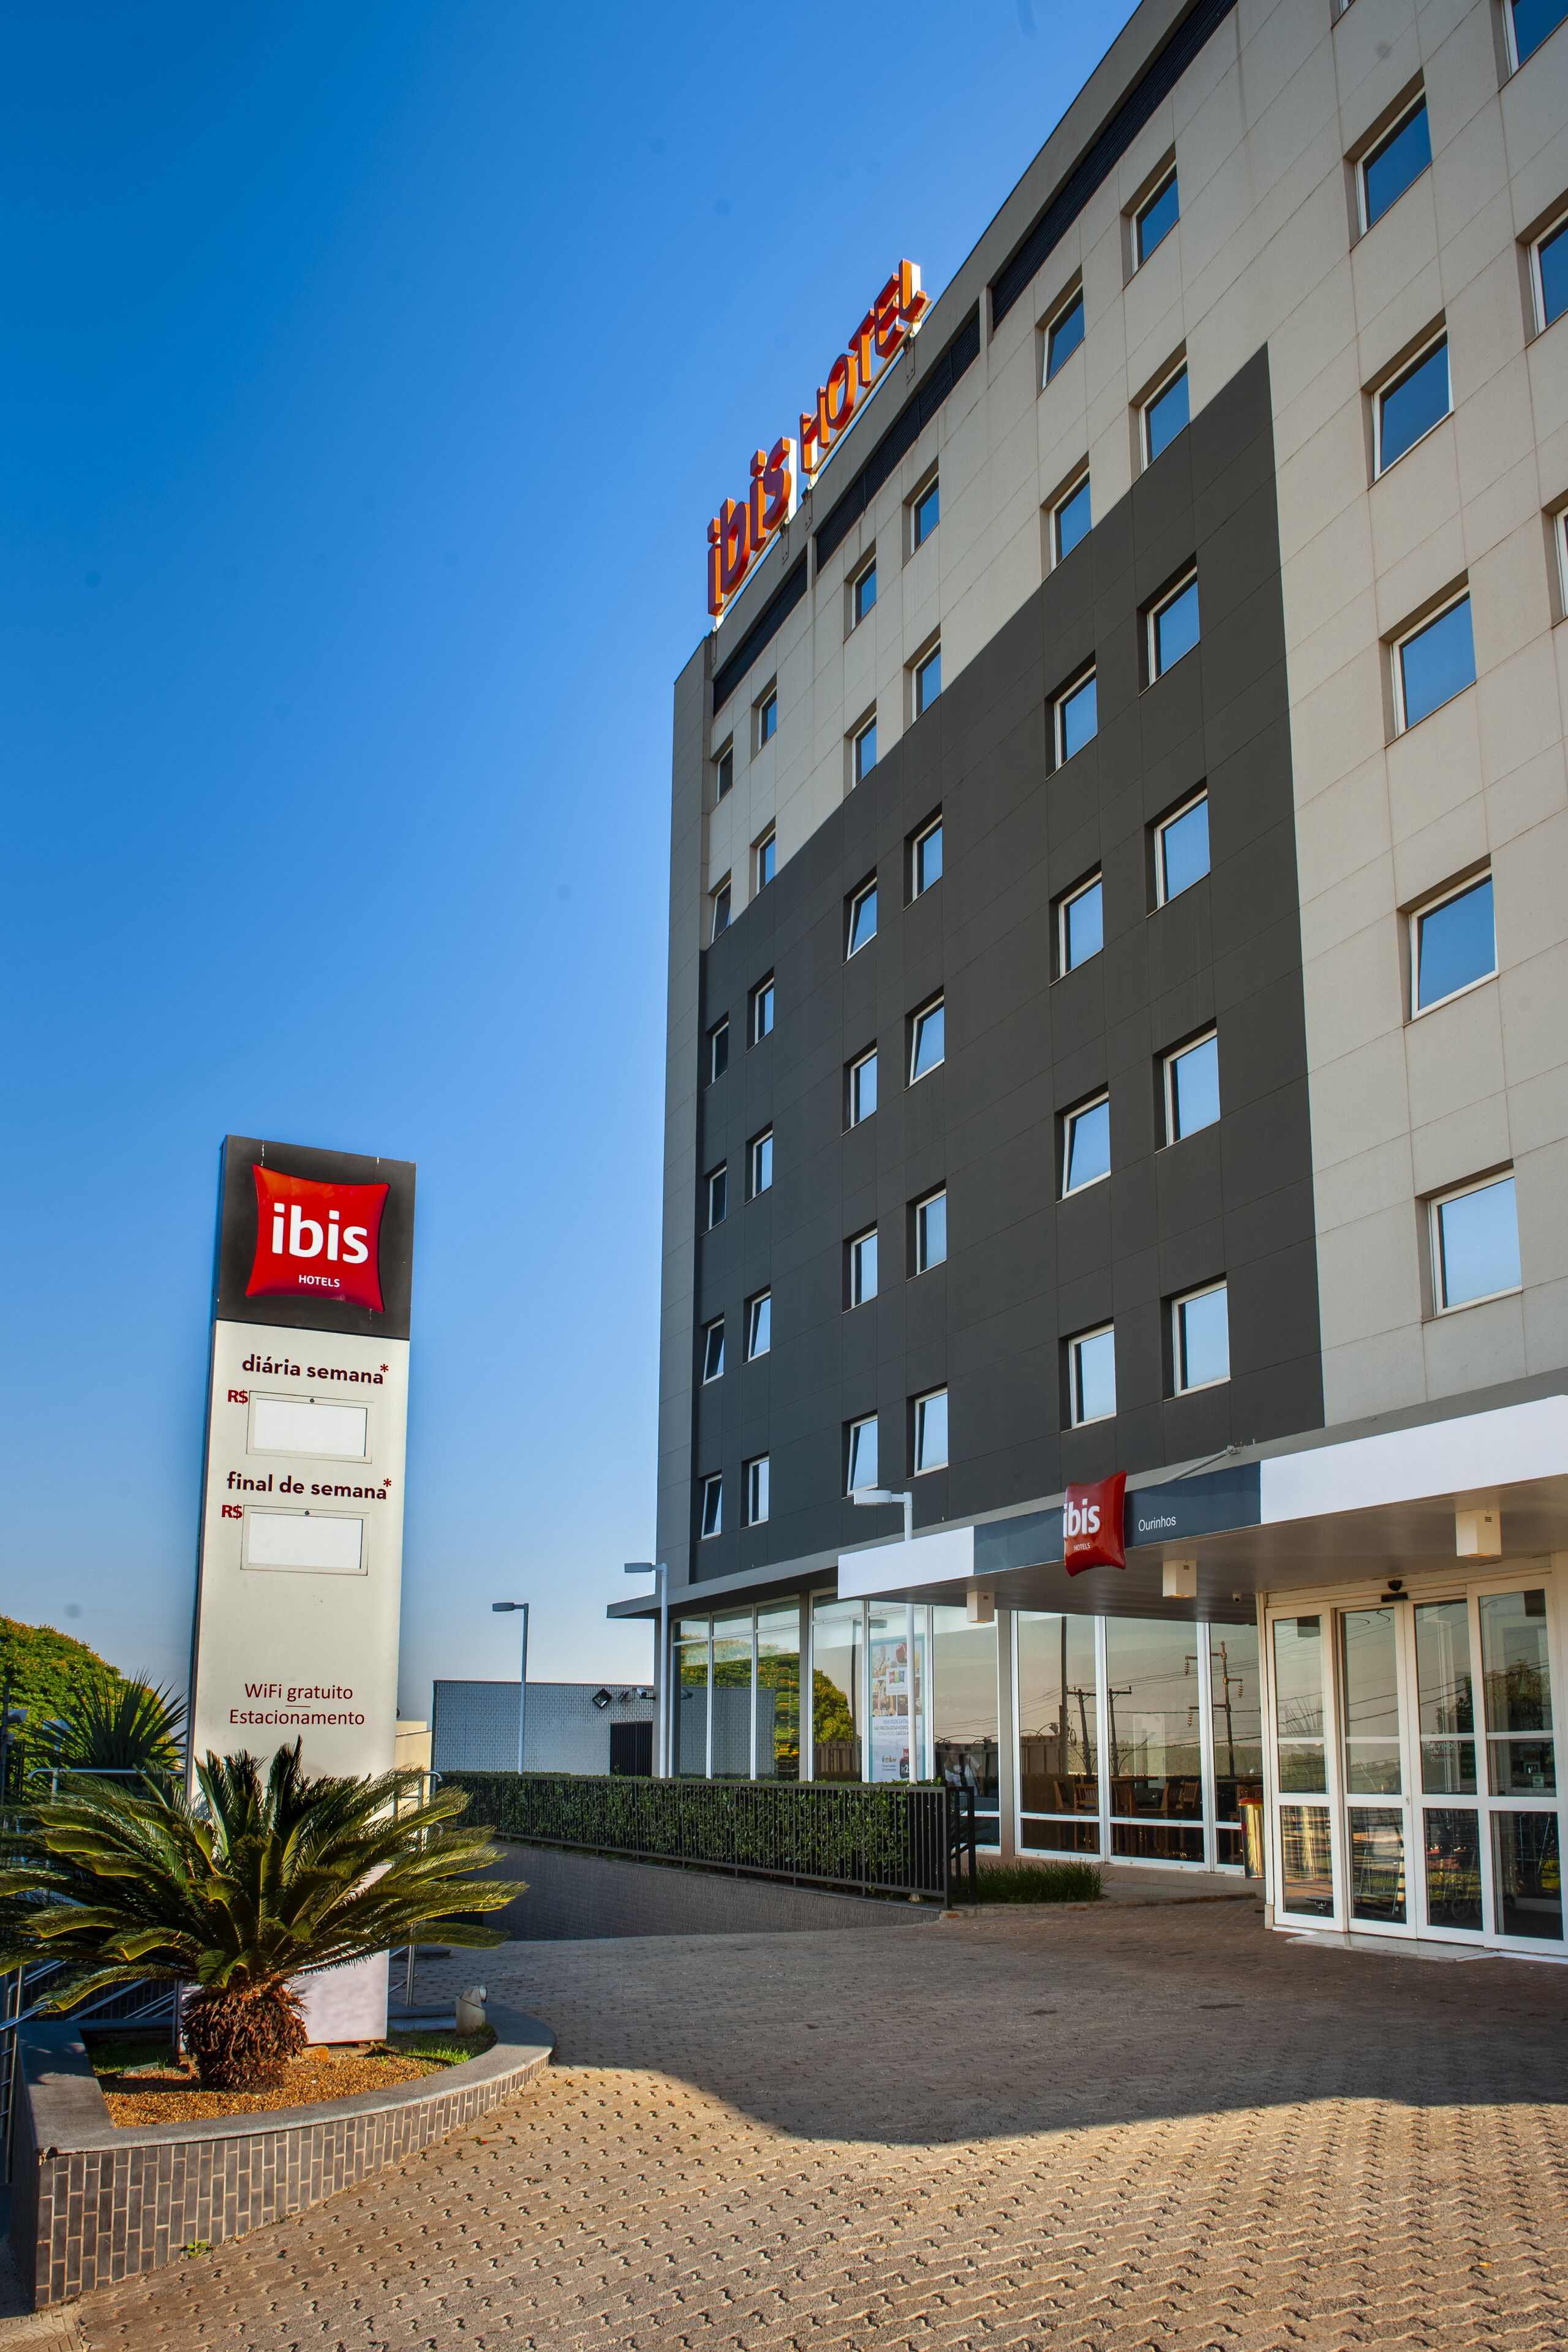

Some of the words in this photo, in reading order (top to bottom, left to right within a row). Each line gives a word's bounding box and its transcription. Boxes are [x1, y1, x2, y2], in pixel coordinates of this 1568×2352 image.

[707, 437, 791, 616] ibis
[799, 258, 927, 474] HOTEL
[272, 1202, 368, 1264] ibis
[298, 1274, 340, 1287] HOTELS
[242, 1354, 301, 1376] diária
[227, 1389, 249, 1404] R$
[227, 1471, 273, 1492] final
[279, 1475, 304, 1494] de
[221, 1504, 243, 1520] R$
[1063, 1498, 1100, 1538] ibis
[1139, 1516, 1176, 1531] Ourinhos
[1074, 1542, 1090, 1551] HOTELS
[245, 1683, 282, 1698] WiFi
[287, 1684, 353, 1702] gratuito
[230, 1709, 365, 1725] Estacionamento
